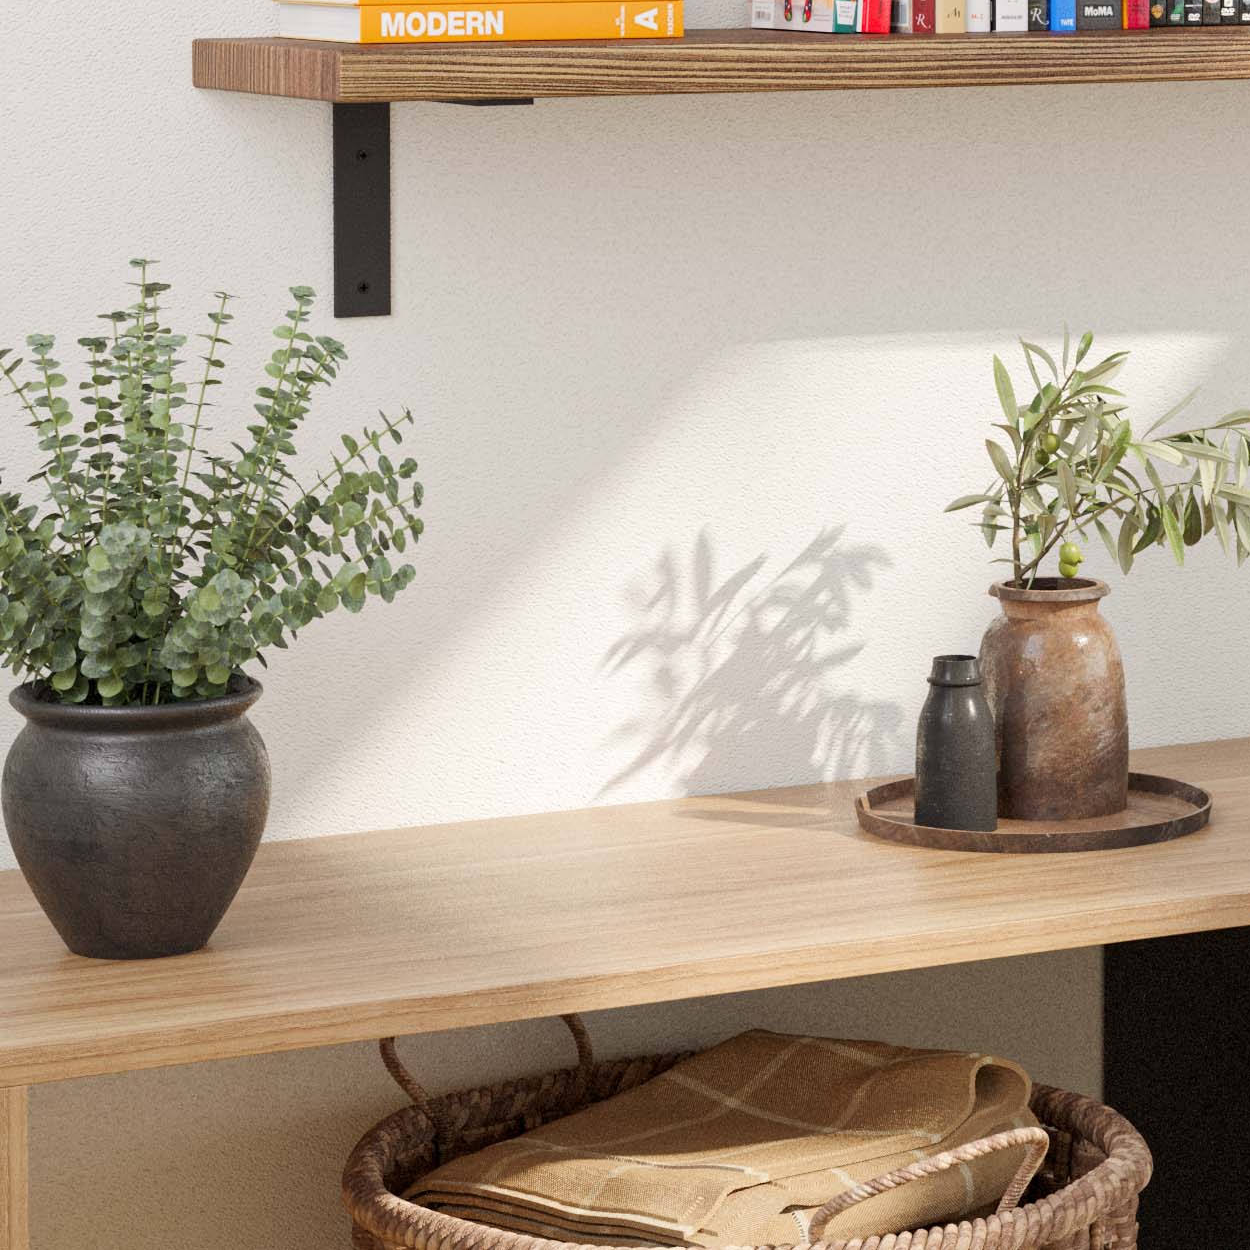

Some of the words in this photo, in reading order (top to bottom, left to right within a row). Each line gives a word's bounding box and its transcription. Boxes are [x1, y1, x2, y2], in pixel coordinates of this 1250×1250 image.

[380, 10, 504, 37] MODERN
[634, 7, 659, 31] A
[1084, 6, 1113, 17] MoMA
